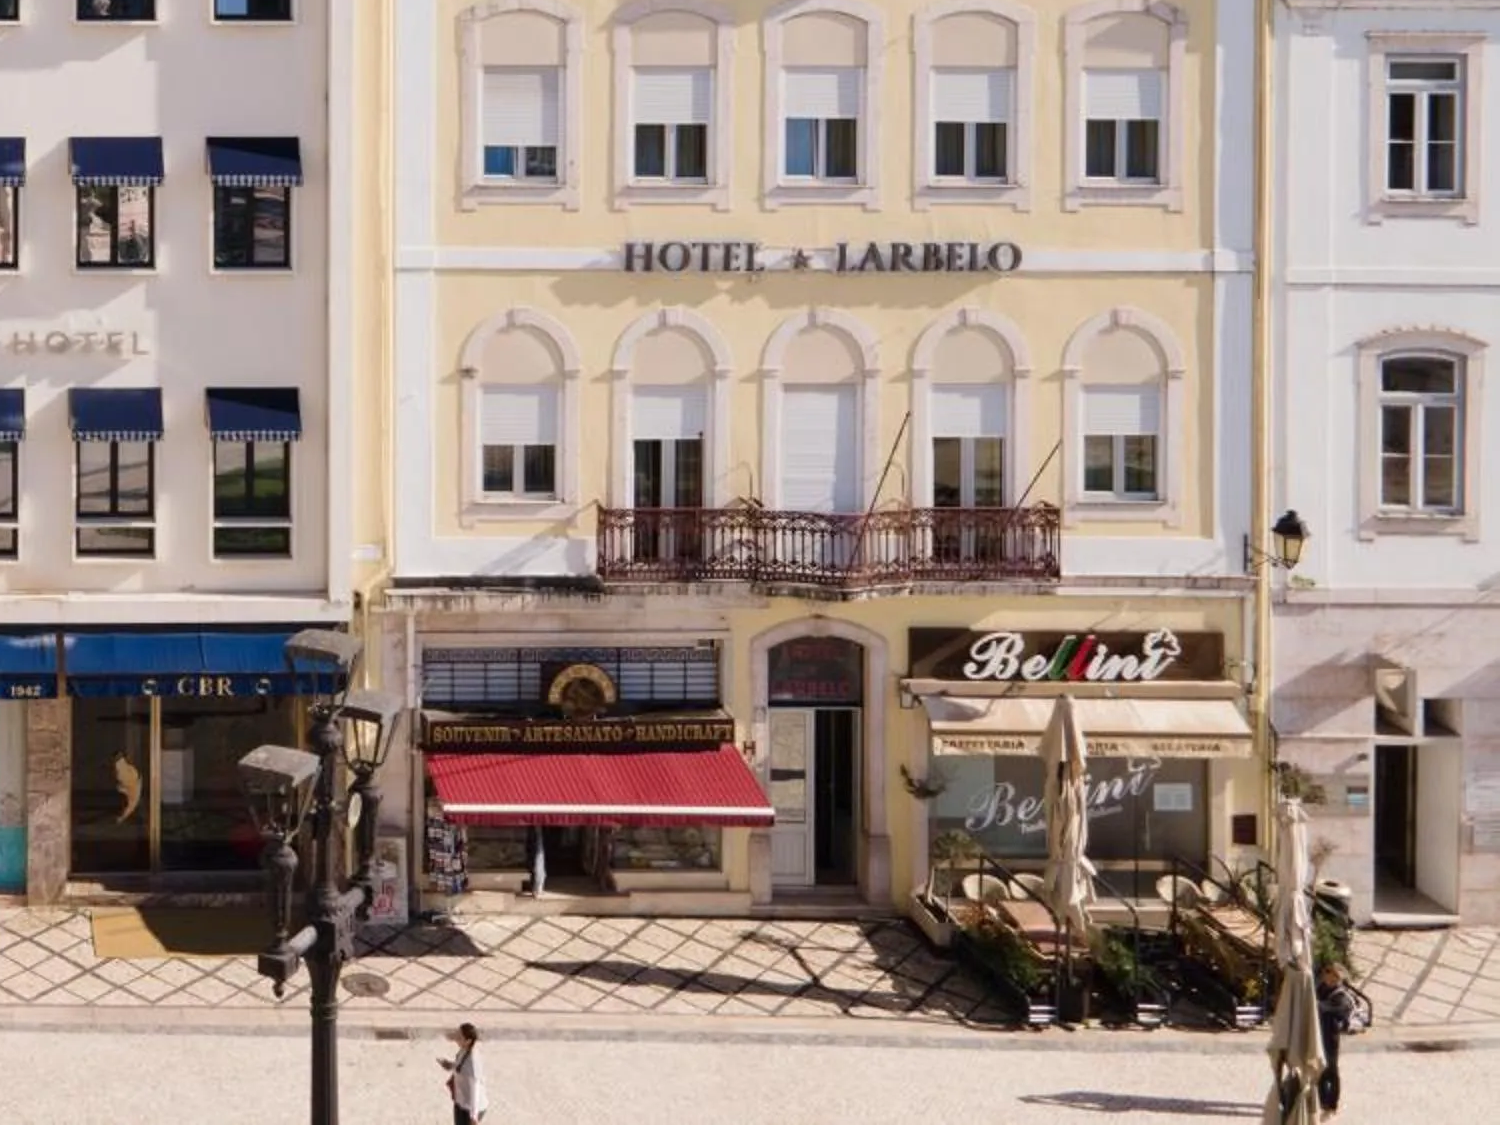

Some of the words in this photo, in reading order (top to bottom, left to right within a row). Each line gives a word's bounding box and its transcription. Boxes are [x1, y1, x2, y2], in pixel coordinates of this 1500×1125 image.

[623, 242, 766, 273] HOTEL
[835, 242, 1023, 273] LARBELO
[10, 330, 151, 356] HOTEL
[963, 627, 1182, 682] Bellini
[10, 686, 42, 697] 1942
[177, 676, 235, 696] CBR
[433, 726, 512, 742] SOUVENIR
[522, 725, 623, 742] ARTESANATO
[636, 724, 733, 741] HANDICRAFT
[965, 757, 1160, 831] Beini
